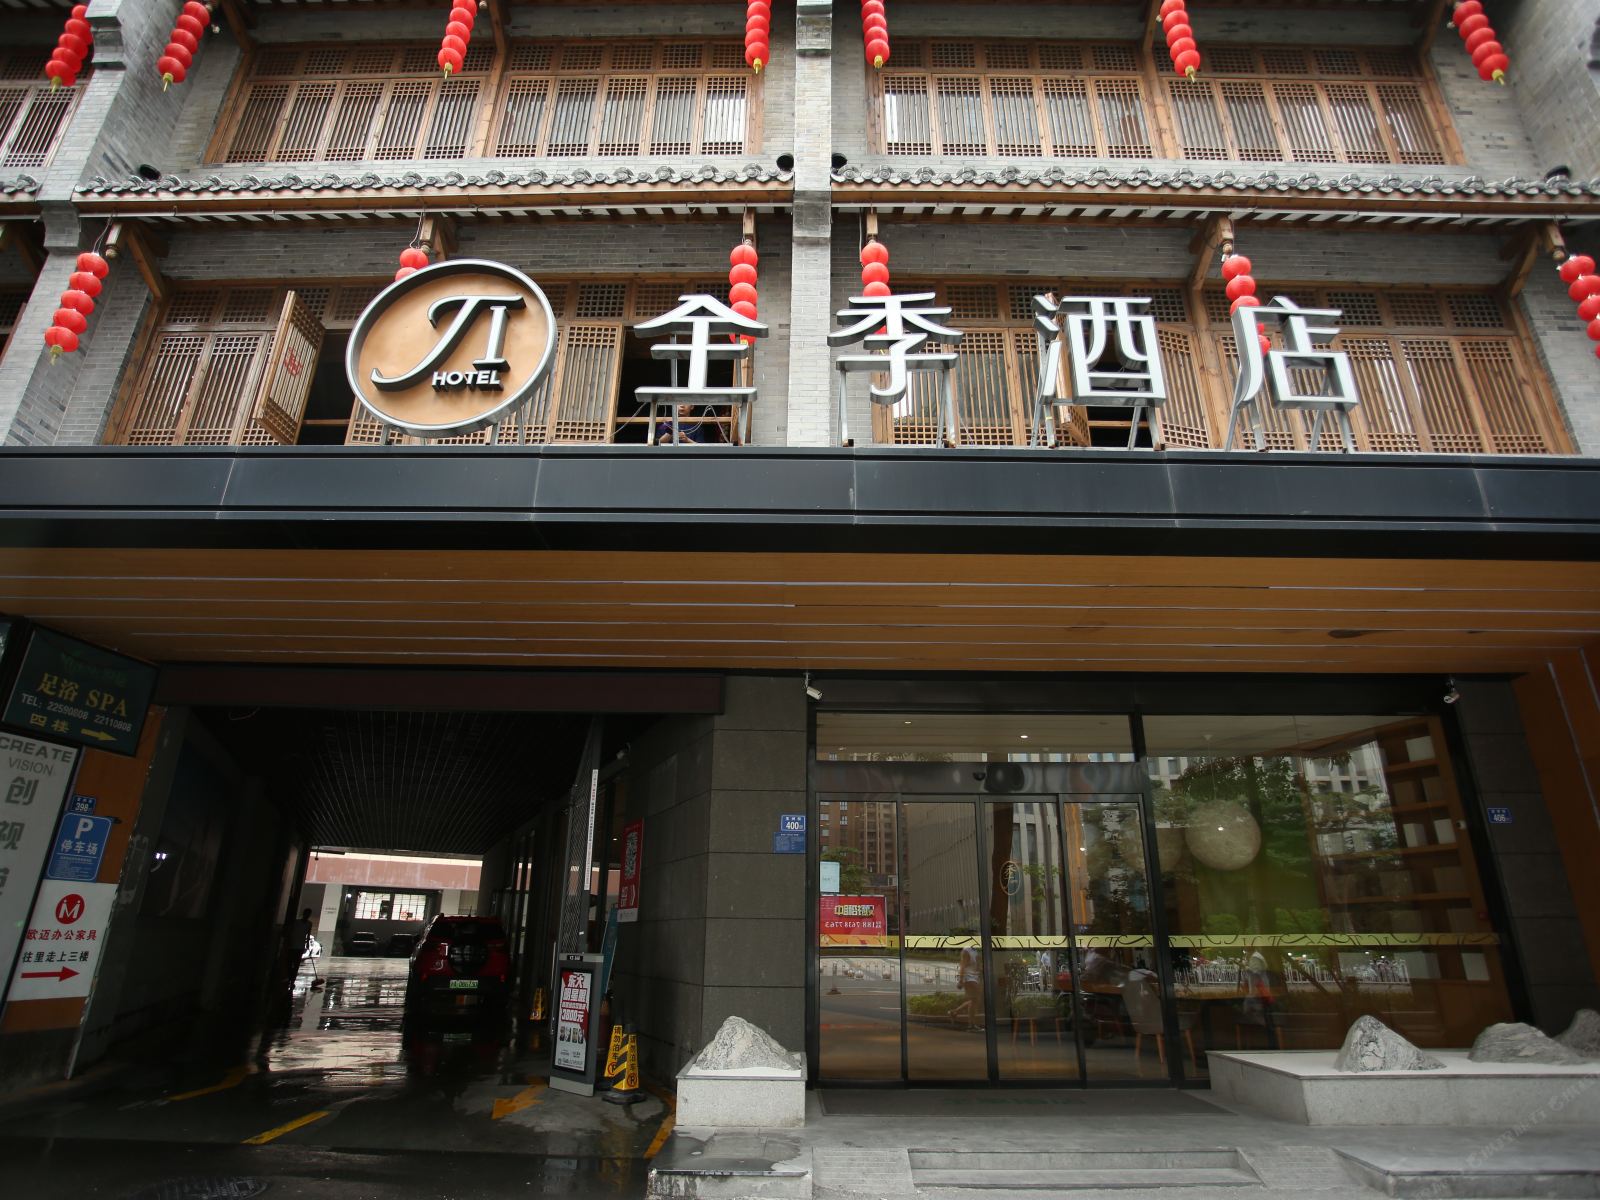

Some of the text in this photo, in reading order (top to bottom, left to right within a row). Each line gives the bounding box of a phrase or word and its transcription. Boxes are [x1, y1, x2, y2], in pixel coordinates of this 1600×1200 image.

[633, 291, 1358, 409] 全季酒店
[432, 369, 502, 391] HOTEL
[36, 672, 128, 717] 足浴 SPA
[30, 713, 70, 733] 四楼
[0, 736, 73, 763] CREATE
[9, 756, 54, 777] VISION
[75, 817, 94, 839] P
[61, 839, 99, 855] 停车场
[26, 929, 97, 941] 欧迈办公家具
[22, 951, 89, 963] 往里走上三楼
